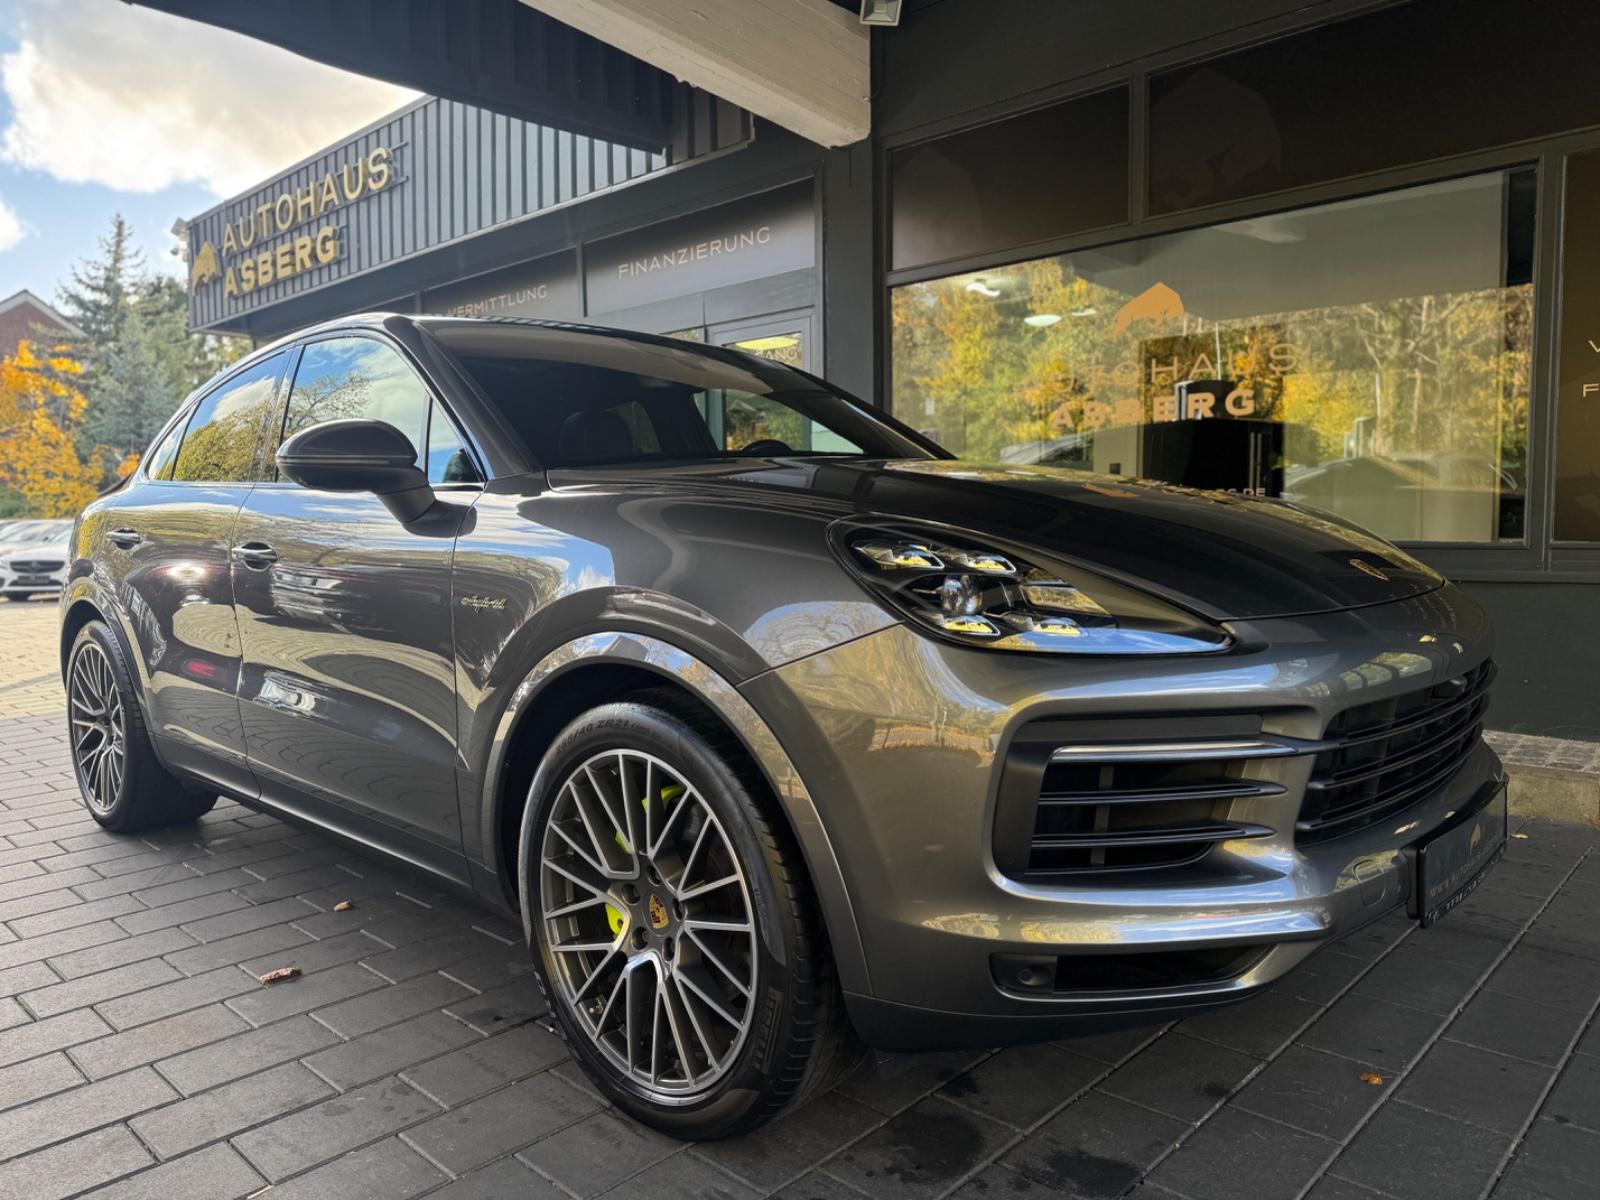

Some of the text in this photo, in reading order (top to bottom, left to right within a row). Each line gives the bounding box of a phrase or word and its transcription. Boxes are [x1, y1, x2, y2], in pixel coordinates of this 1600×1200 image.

[222, 147, 392, 256] AUTOHAUS
[224, 225, 337, 299] ASBERG
[618, 226, 771, 279] FINANZIERUNG
[447, 284, 548, 317] VERMITTLUNG
[1050, 343, 1298, 394] UTOHAUS
